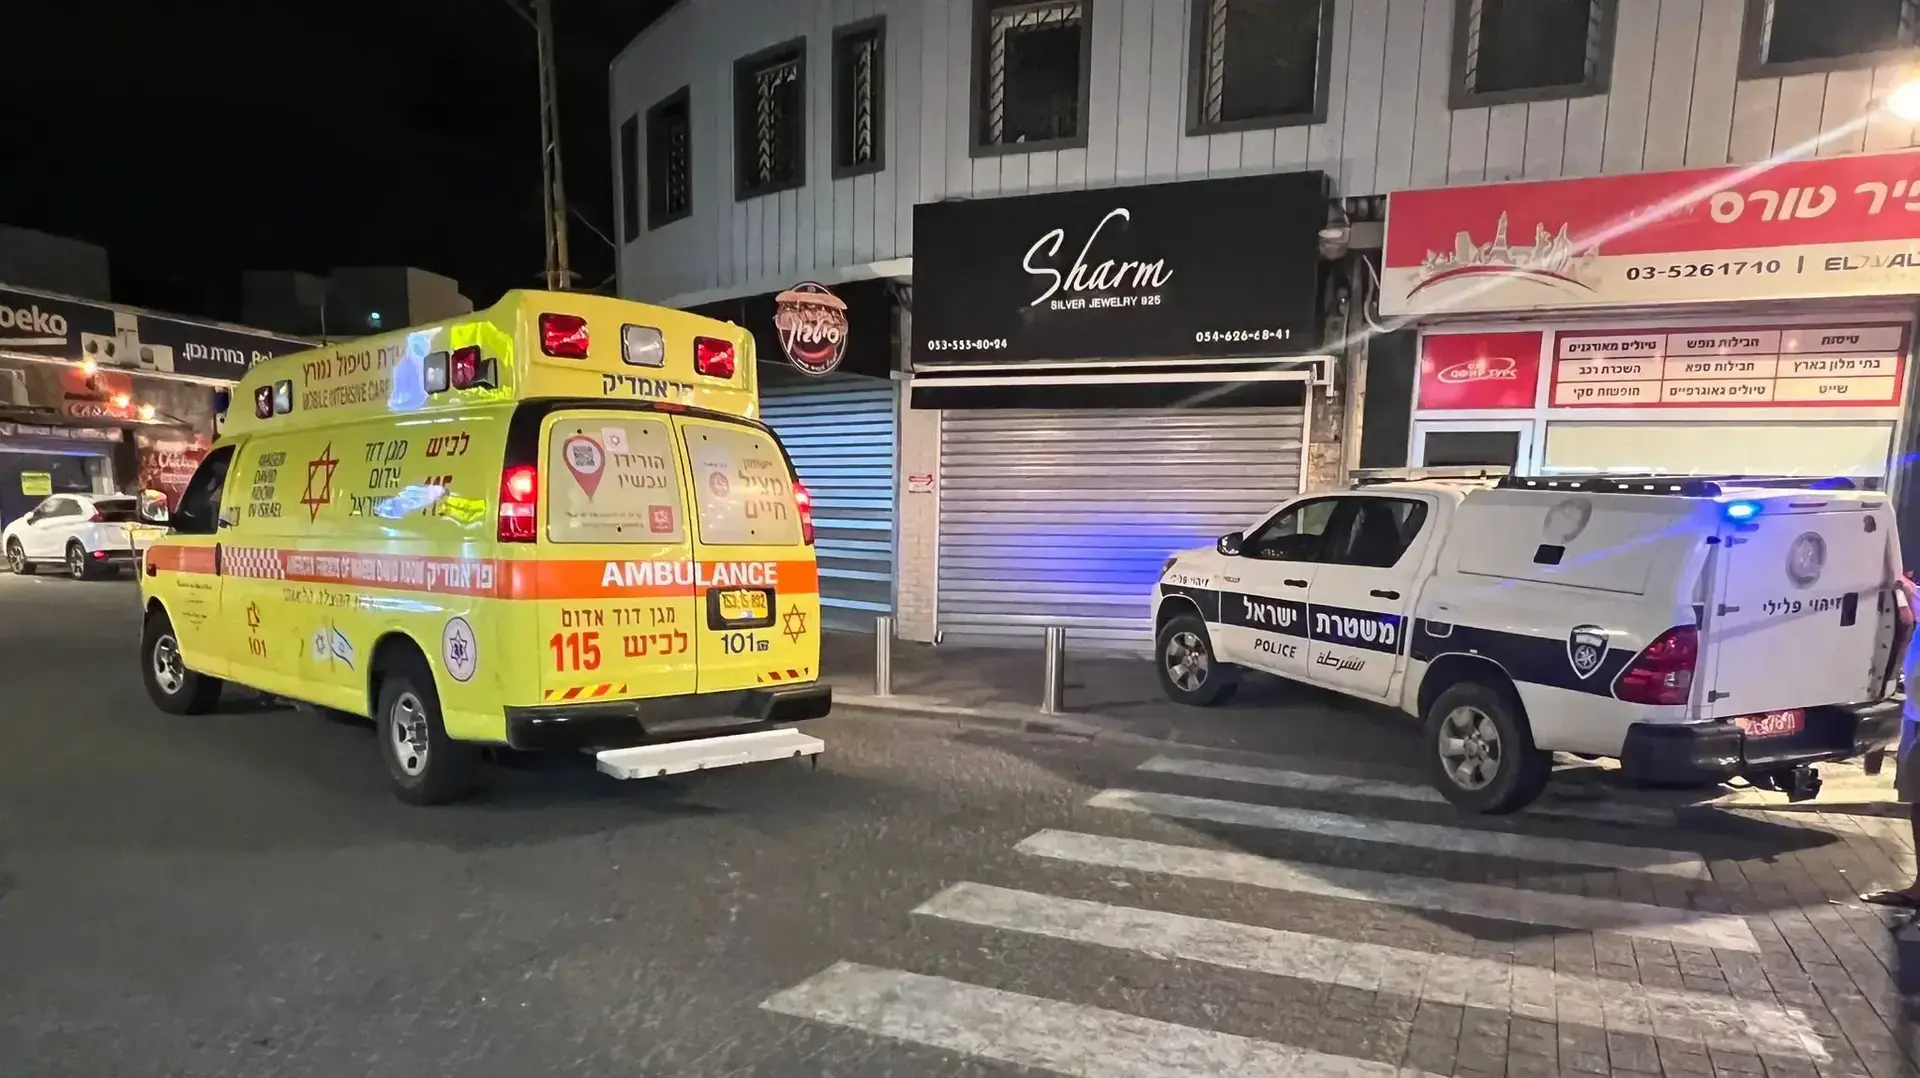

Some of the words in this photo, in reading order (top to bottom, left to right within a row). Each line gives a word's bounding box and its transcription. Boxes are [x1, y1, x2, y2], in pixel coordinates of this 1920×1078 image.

[1709, 185, 1837, 224] טורס
[1023, 207, 1173, 306] Sharm
[1626, 259, 1781, 281] 03-5261710
[1050, 298, 1085, 310] SILVER
[1089, 296, 1138, 308] JEWELRY
[1195, 328, 1290, 342] 054-626-68-41
[1718, 336, 1760, 348] חבילות
[210, 345, 245, 364] בחרת
[1568, 342, 1619, 353] מאורגנים
[1621, 340, 1657, 351] טיולים
[336, 350, 370, 376] טיפול
[1579, 366, 1599, 375] רכב
[1601, 364, 1641, 374] השכרת
[1685, 363, 1711, 372] ספא
[1714, 361, 1755, 372] חבילות
[1794, 360, 1826, 373] בארץ
[1829, 358, 1855, 372] מלון
[1858, 359, 1881, 369] בתי
[303, 359, 331, 387] נמרץ
[1573, 387, 1593, 400] סקי
[1669, 386, 1726, 396] גאוגרפיים
[1729, 384, 1766, 395] טיולים
[1819, 384, 1848, 394] שייט
[384, 440, 409, 465] מגן
[426, 431, 470, 457] לכיש
[614, 453, 665, 470] הורידו
[369, 467, 401, 489] אדום
[618, 474, 667, 488] עכשיו
[745, 500, 787, 520] חיים
[427, 560, 493, 592] פראמדיק
[601, 561, 778, 587] AMBULANCE
[1243, 595, 1297, 627] ישראל
[1763, 597, 1802, 615] פלילי
[1809, 597, 1842, 612] זיהוי
[561, 608, 604, 628] אדום
[612, 608, 641, 625] דוד
[649, 606, 676, 627] מגן
[1316, 613, 1395, 645] משטרת
[248, 636, 267, 658] 101
[550, 631, 601, 672] 115
[623, 628, 688, 657] לכיש
[720, 632, 754, 654] 101
[1254, 638, 1297, 659] POLICE
